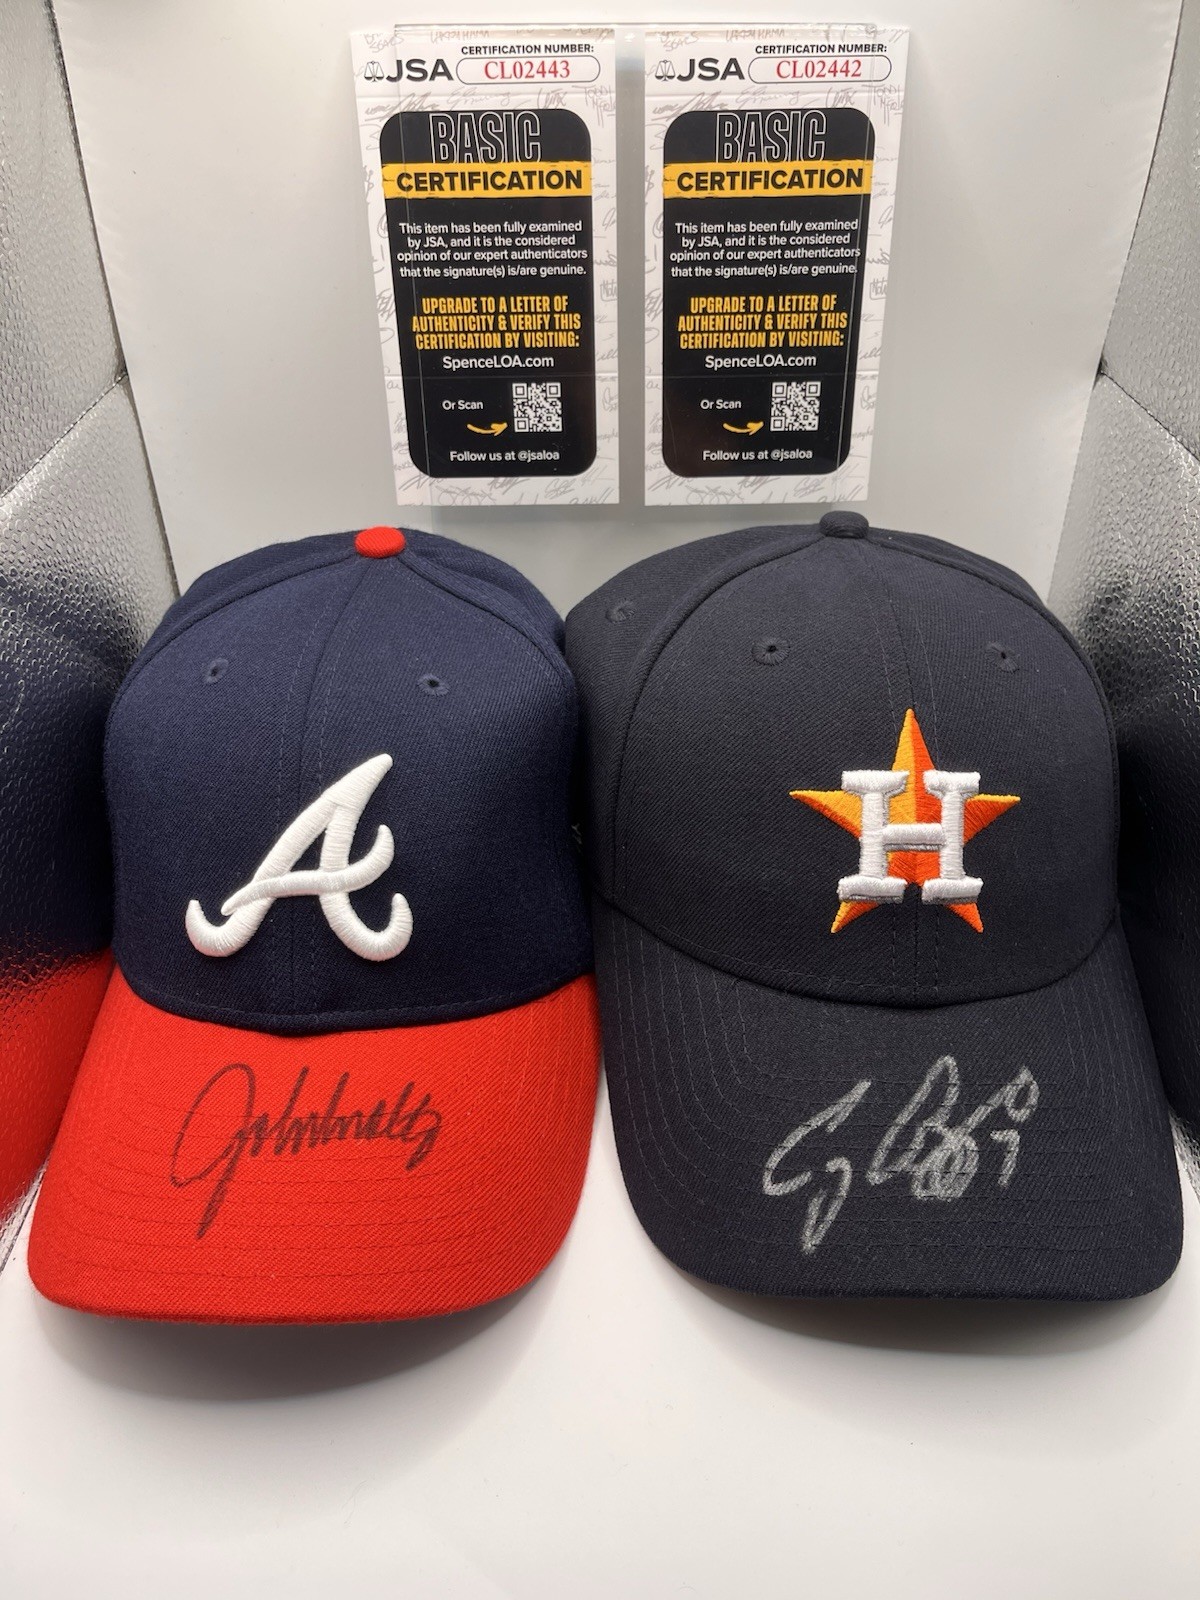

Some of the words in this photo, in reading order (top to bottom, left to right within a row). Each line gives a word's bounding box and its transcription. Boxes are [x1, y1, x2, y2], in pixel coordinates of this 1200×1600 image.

[461, 46, 542, 55] CERTIFICATION
[544, 44, 594, 54] NUMBER:
[755, 45, 835, 54] CERTIFICATION
[838, 44, 887, 53] NUMBER:
[386, 59, 454, 82] JSA
[484, 60, 571, 79] CL02443
[677, 58, 745, 81] JSA
[776, 60, 862, 79] CL02442
[430, 111, 541, 164] BASIC
[716, 110, 826, 164] BASIC
[397, 170, 582, 191] CERTIFICATION
[677, 168, 863, 191] CERTIFICATION
[399, 223, 422, 234] This
[424, 223, 449, 234] item
[451, 223, 470, 233] has
[473, 222, 501, 233] been
[503, 222, 526, 234] fully
[529, 221, 582, 232] examined
[675, 223, 698, 234] This
[700, 223, 724, 233] item
[727, 222, 747, 233] has
[749, 221, 777, 232] been
[780, 220, 802, 233] fully
[805, 219, 858, 230] examined
[407, 238, 421, 250] by
[423, 237, 448, 248] JSA,
[450, 236, 471, 247] and
[473, 236, 481, 246] it
[483, 236, 492, 246] is
[494, 236, 512, 246] the
[515, 235, 576, 246] considered
[682, 237, 695, 250] by
[698, 237, 723, 248] JSA,
[725, 236, 746, 246] and
[748, 235, 755, 246] it
[757, 235, 766, 245] is
[769, 235, 787, 245] the
[789, 233, 850, 245] considered
[397, 251, 438, 262] opinion
[440, 251, 451, 261] of
[453, 252, 472, 260] our
[474, 251, 508, 261] expert
[511, 249, 588, 260] authenticators
[670, 251, 710, 263] opinion
[713, 250, 724, 260] of
[727, 251, 745, 260] our
[747, 250, 782, 261] expert
[784, 247, 861, 259] authenticators
[400, 267, 422, 278] that
[423, 267, 441, 277] the
[444, 265, 505, 279] signature(s)
[508, 265, 537, 276] is/are
[540, 265, 586, 278] genuine.
[671, 267, 693, 277] that
[695, 266, 712, 276] the
[715, 265, 777, 279] signature(s)
[779, 264, 809, 275] is/are
[811, 264, 858, 276] genuine.
[422, 297, 477, 314] UPGRADE
[481, 297, 495, 312] TO
[500, 297, 507, 312] A
[510, 296, 550, 312] LETTER
[554, 296, 568, 312] OF
[690, 297, 746, 313] UPGRADE
[749, 297, 763, 312] TO
[767, 297, 775, 312] A
[779, 296, 819, 312] LETTER
[822, 295, 837, 311] OF
[412, 315, 494, 332] AUTHENTICITY
[498, 315, 507, 330] &
[510, 314, 550, 331] VERIFY
[554, 313, 581, 329] THIS
[678, 315, 761, 332] AUTHENTICITY
[765, 314, 773, 330] &
[776, 313, 817, 330] VERIFY
[821, 312, 847, 328] THIS
[415, 333, 501, 350] CERTIFICATION
[505, 333, 520, 348] BY
[524, 332, 580, 348] VISITING:
[680, 332, 765, 349] CERTIFICATION
[769, 332, 784, 348] BY
[788, 331, 844, 347] VISITING:
[443, 355, 554, 371] SpenceLOA.com
[705, 354, 817, 371] SpenceLOA.com
[442, 401, 455, 410] Or
[458, 400, 483, 410] Scan
[700, 400, 714, 409] Or
[716, 399, 742, 409] Scan
[450, 451, 487, 462] Follow
[489, 452, 502, 461] us
[504, 452, 516, 460] at
[518, 450, 560, 462] @jsaloa
[703, 450, 739, 461] Follow
[742, 452, 755, 460] us
[757, 451, 768, 459] at
[771, 449, 812, 462] @jsaloa
[838, 769, 983, 904] H
[185, 753, 413, 962] A
